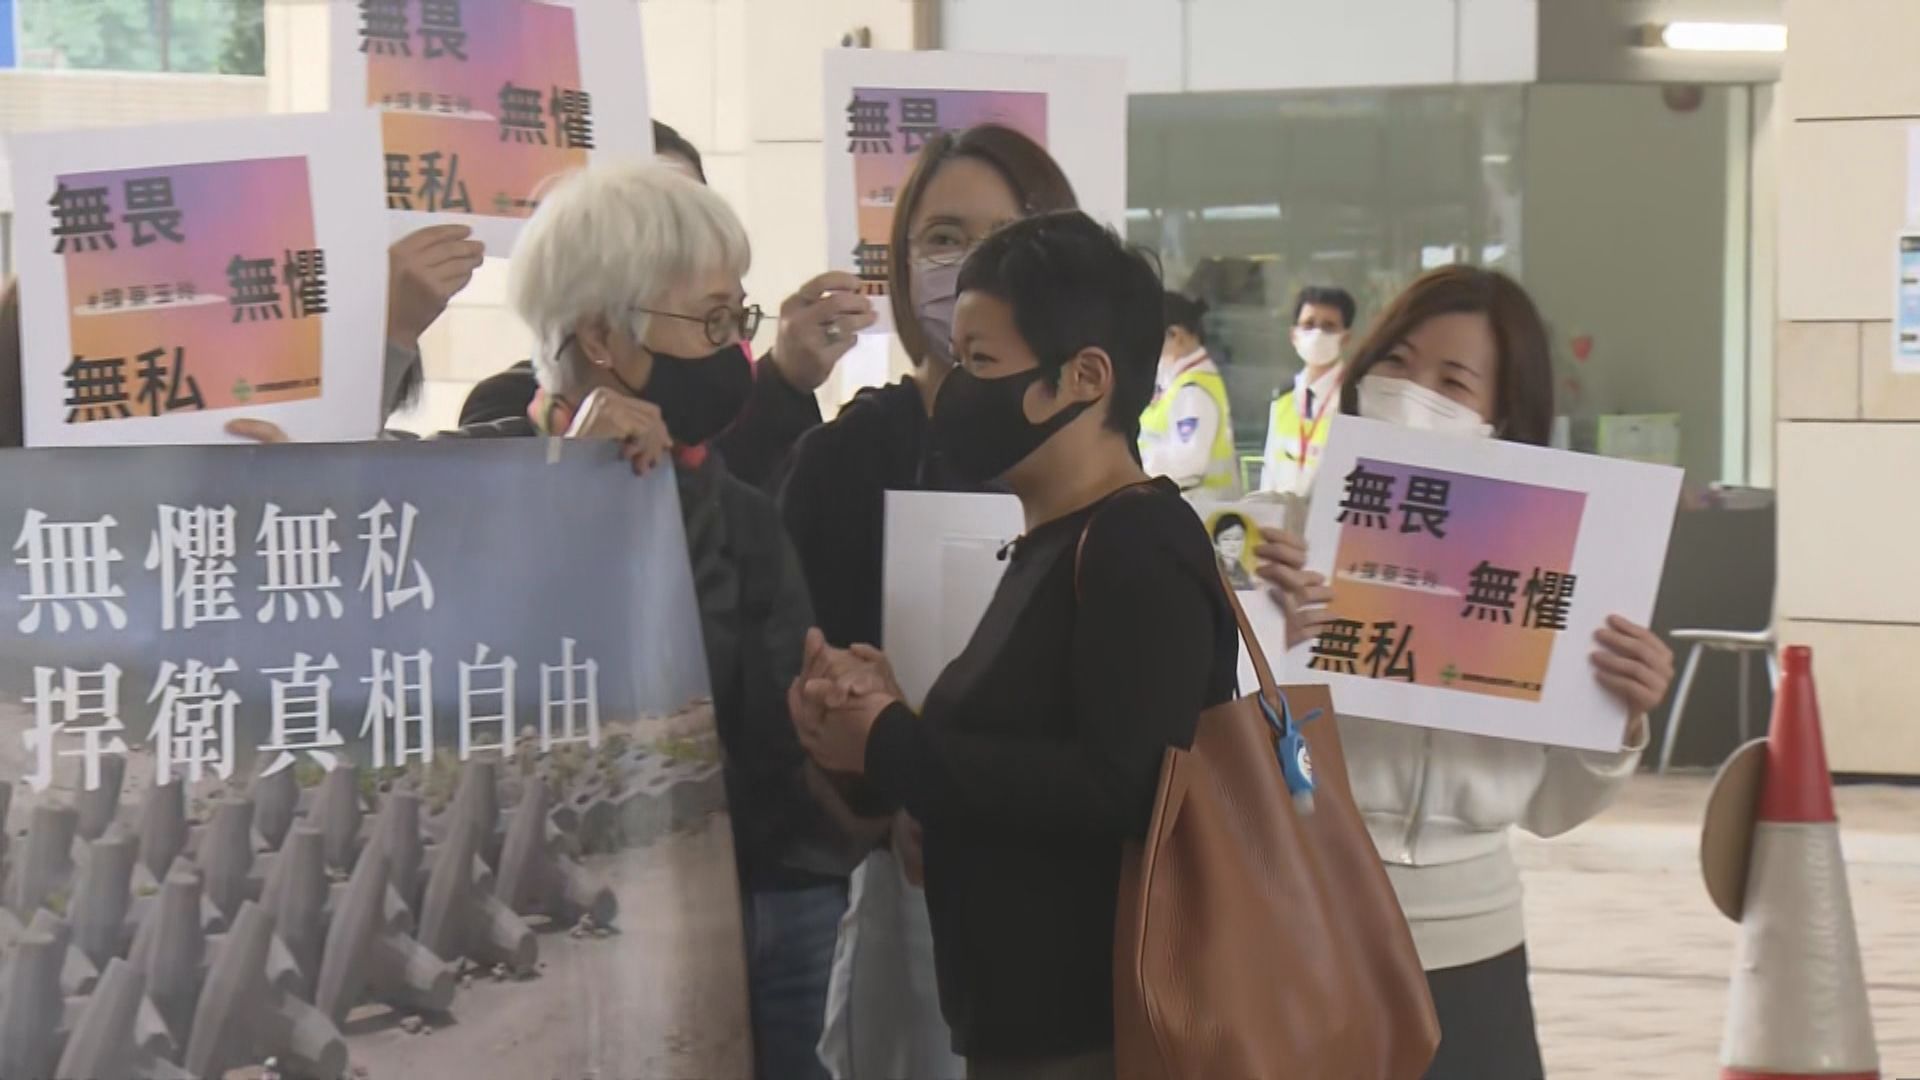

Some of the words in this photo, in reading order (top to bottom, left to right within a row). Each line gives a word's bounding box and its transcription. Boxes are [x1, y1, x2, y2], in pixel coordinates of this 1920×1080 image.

[498, 80, 597, 150] 無懼
[48, 175, 185, 254] 無畏
[227, 248, 329, 323] 無懼
[62, 346, 206, 424] 無私
[1335, 464, 1451, 539] 無畏
[13, 498, 435, 634] 無懼無私
[1461, 559, 1578, 632] 無懼
[1306, 618, 1417, 684] 無私
[20, 637, 601, 793] 捍衛真相自由
